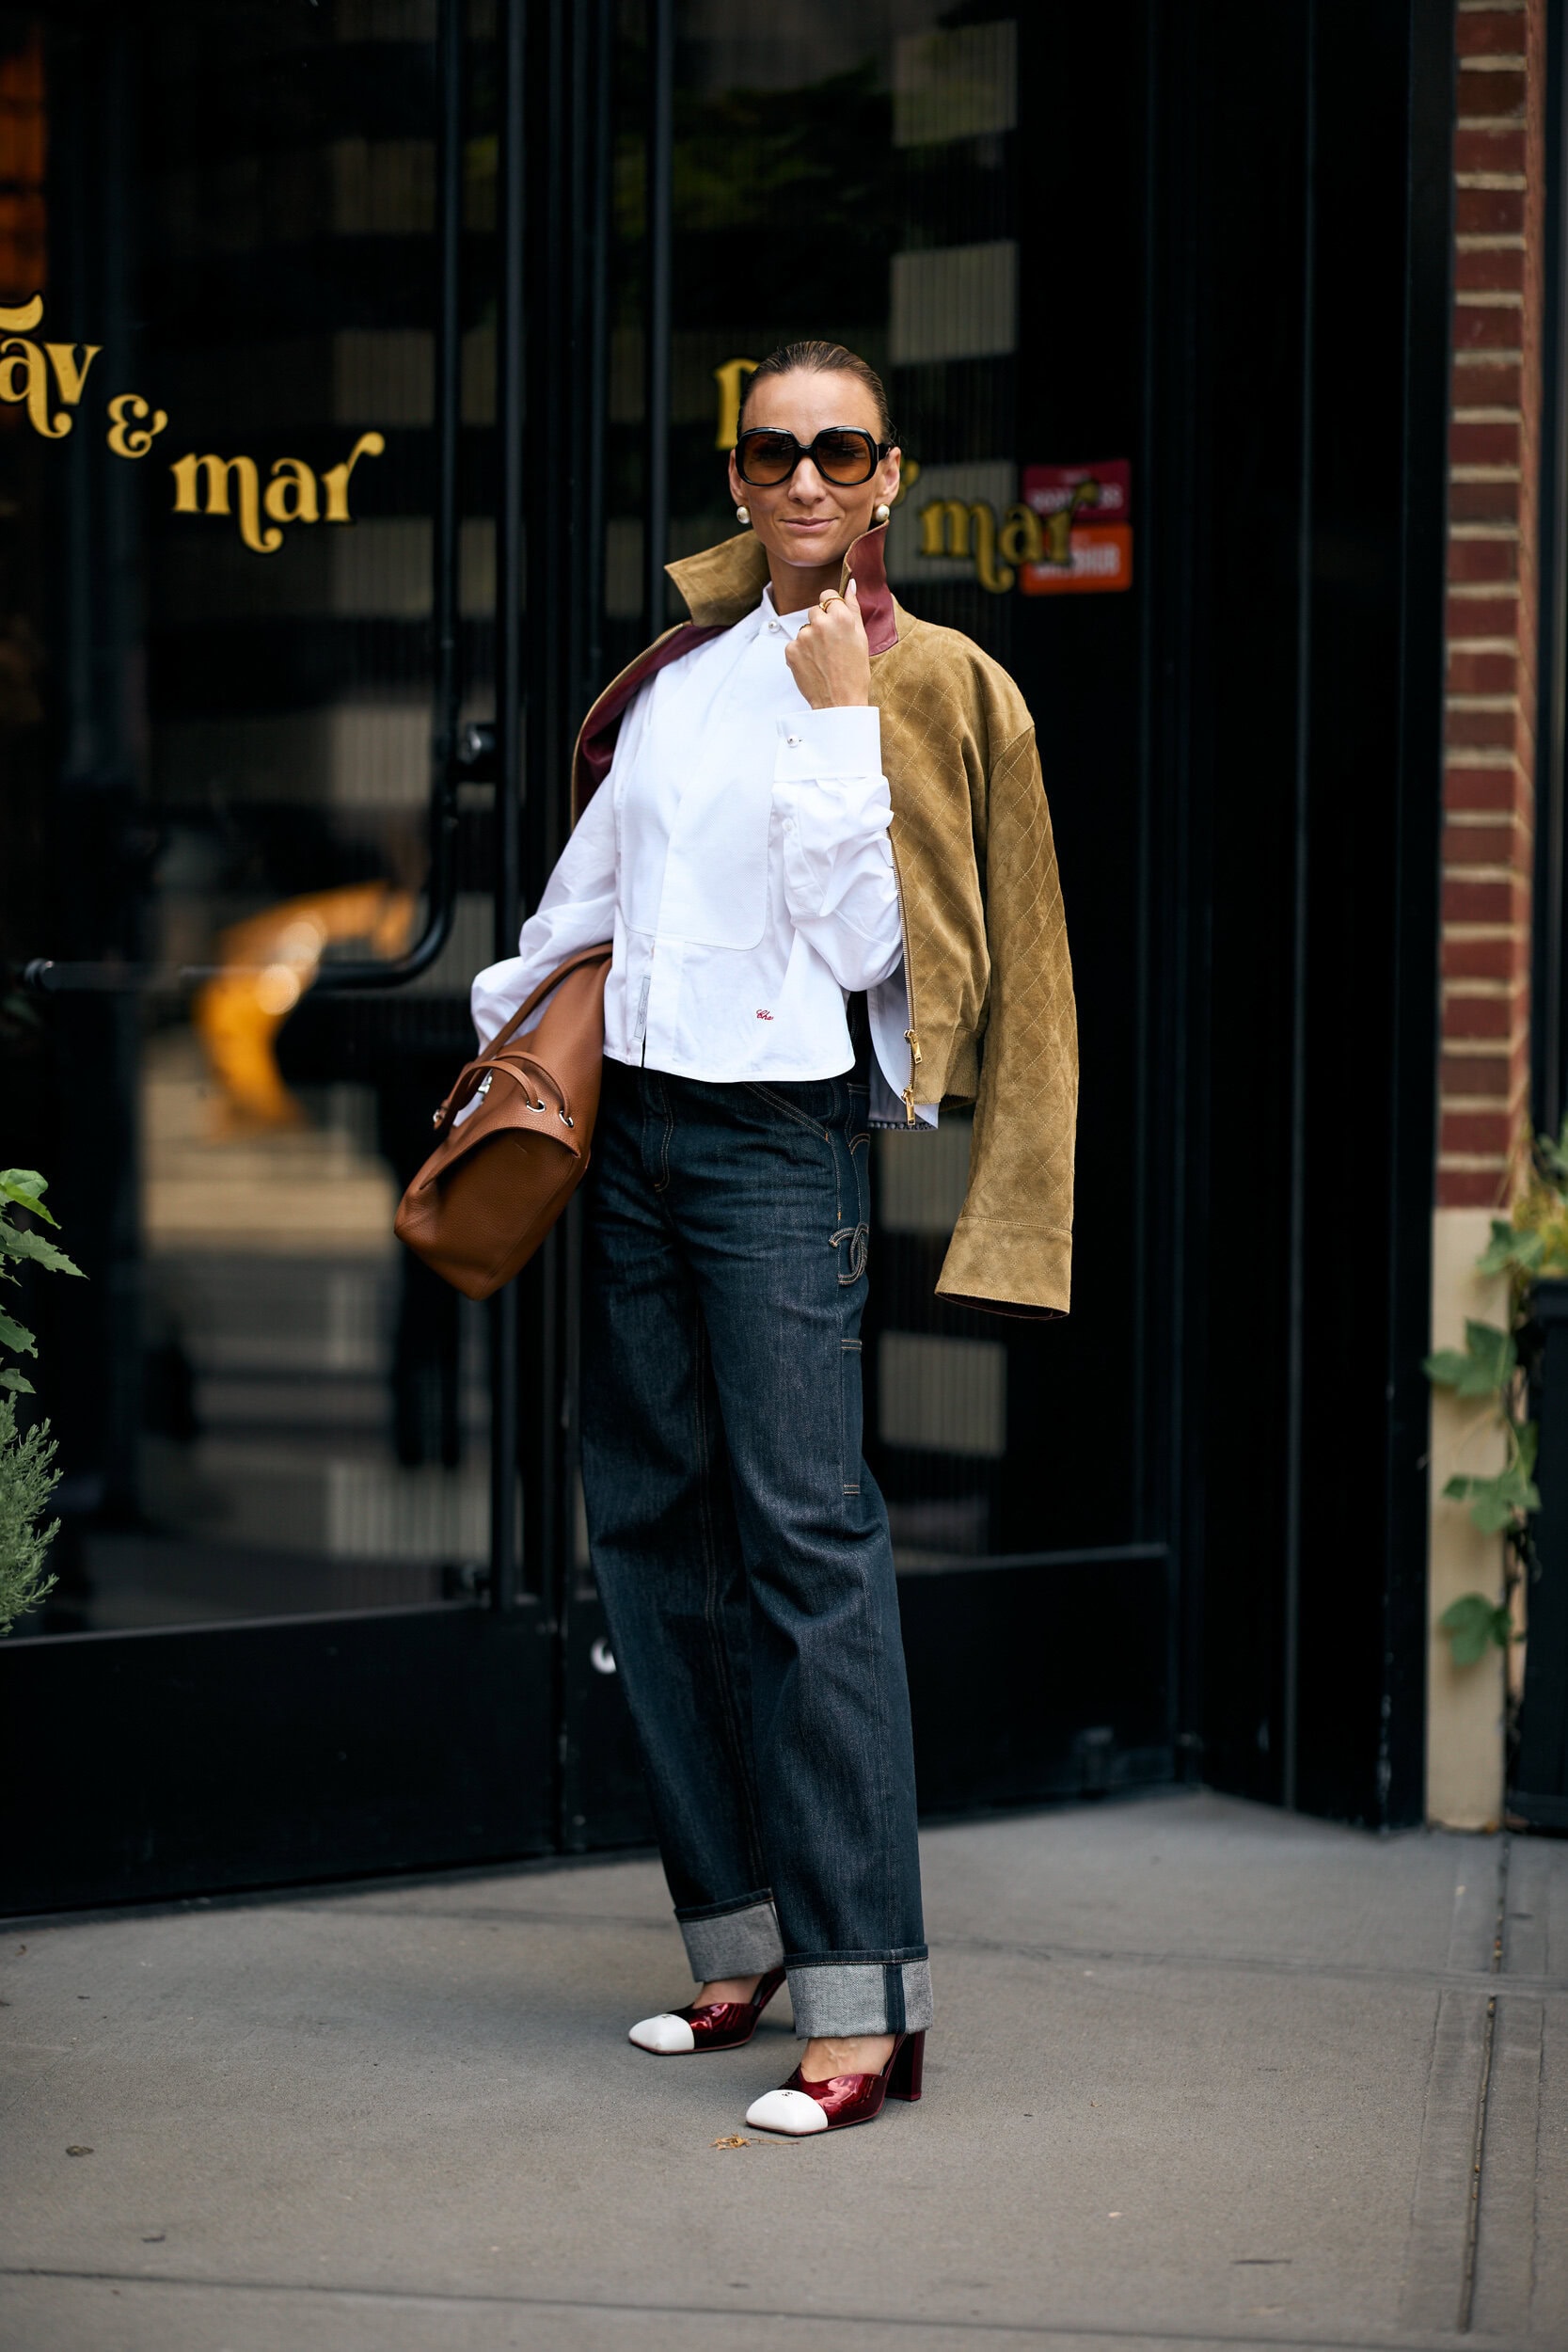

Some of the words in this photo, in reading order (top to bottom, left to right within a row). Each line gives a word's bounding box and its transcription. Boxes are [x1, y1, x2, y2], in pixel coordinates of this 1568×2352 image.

[107, 394, 168, 458] &
[170, 432, 385, 553] mar
[920, 484, 1098, 593] mar
